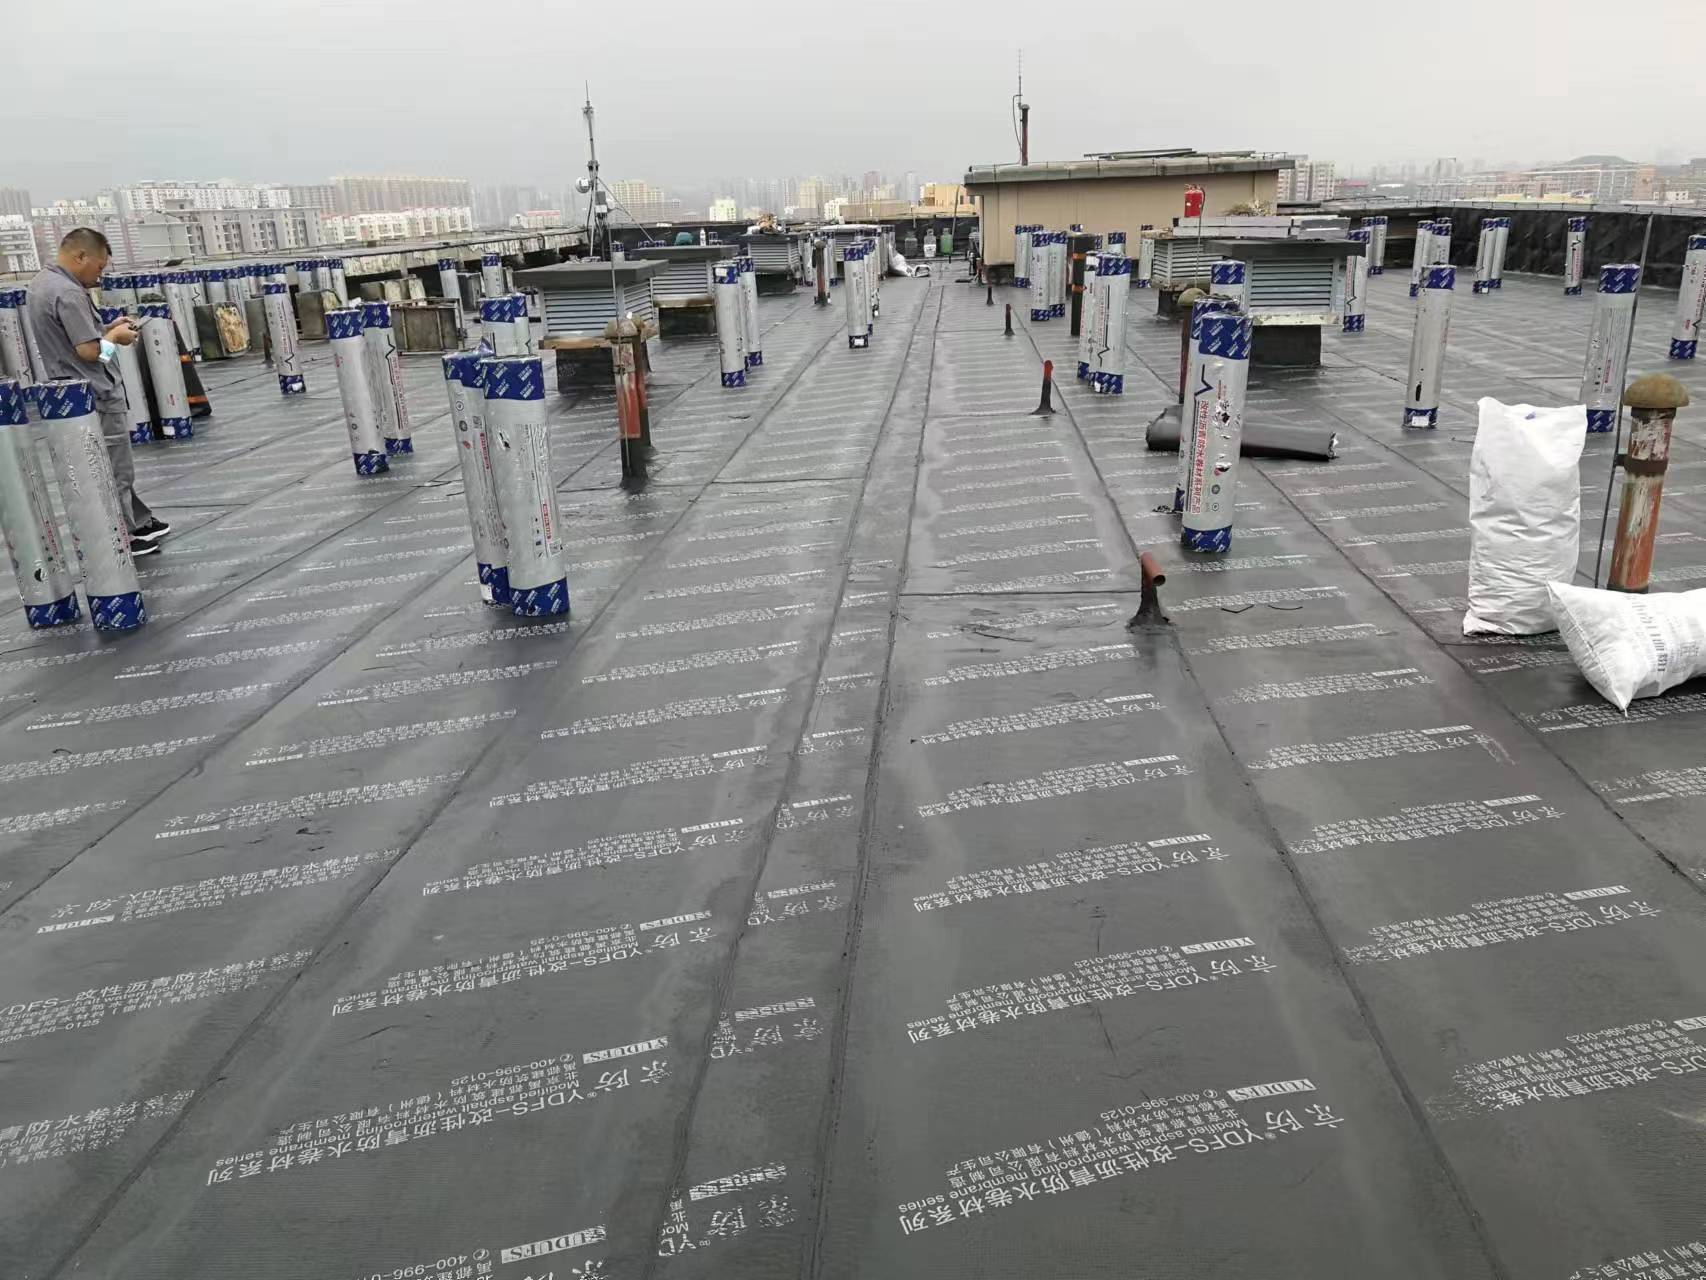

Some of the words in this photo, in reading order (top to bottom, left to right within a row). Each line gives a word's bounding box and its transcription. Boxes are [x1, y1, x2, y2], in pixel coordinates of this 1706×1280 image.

[1512, 807, 1565, 824] 京防
[1173, 847, 1229, 867] 京防
[914, 860, 1169, 912] YDFS-改性沥青防水卷材系列
[1600, 902, 1661, 924] 京防
[652, 928, 712, 948] 京防
[1143, 965, 1196, 978] Modified
[1211, 955, 1277, 979] 京防
[330, 946, 642, 1019] YDFS-改性沥青防水卷材系列
[1097, 971, 1143, 986] asphalt
[1014, 981, 1099, 1002] waterproofing
[907, 971, 1208, 1042] YDFS-改性沥青防水卷材系列
[947, 997, 1013, 1016] membrane
[906, 1014, 944, 1027] series
[451, 1056, 554, 1085] 400-996-0125
[463, 1089, 515, 1110] asphalt
[520, 1080, 579, 1097] Modified
[1097, 1091, 1201, 1121] 400-996-0125
[356, 1103, 459, 1134] waterproofing
[1184, 1118, 1247, 1136] Modified
[1266, 1104, 1344, 1137] 京防
[203, 1087, 583, 1191] YDFS-改性沥青防水卷材系列
[269, 1128, 351, 1156] membrane
[1129, 1127, 1184, 1149] asphalt
[216, 1153, 261, 1172] series
[1029, 1142, 1131, 1174] waterproofing
[898, 1127, 1263, 1235] YDFS-改性沥青防水卷材系列
[947, 1167, 1027, 1196] membrane
[896, 1193, 944, 1213] series
